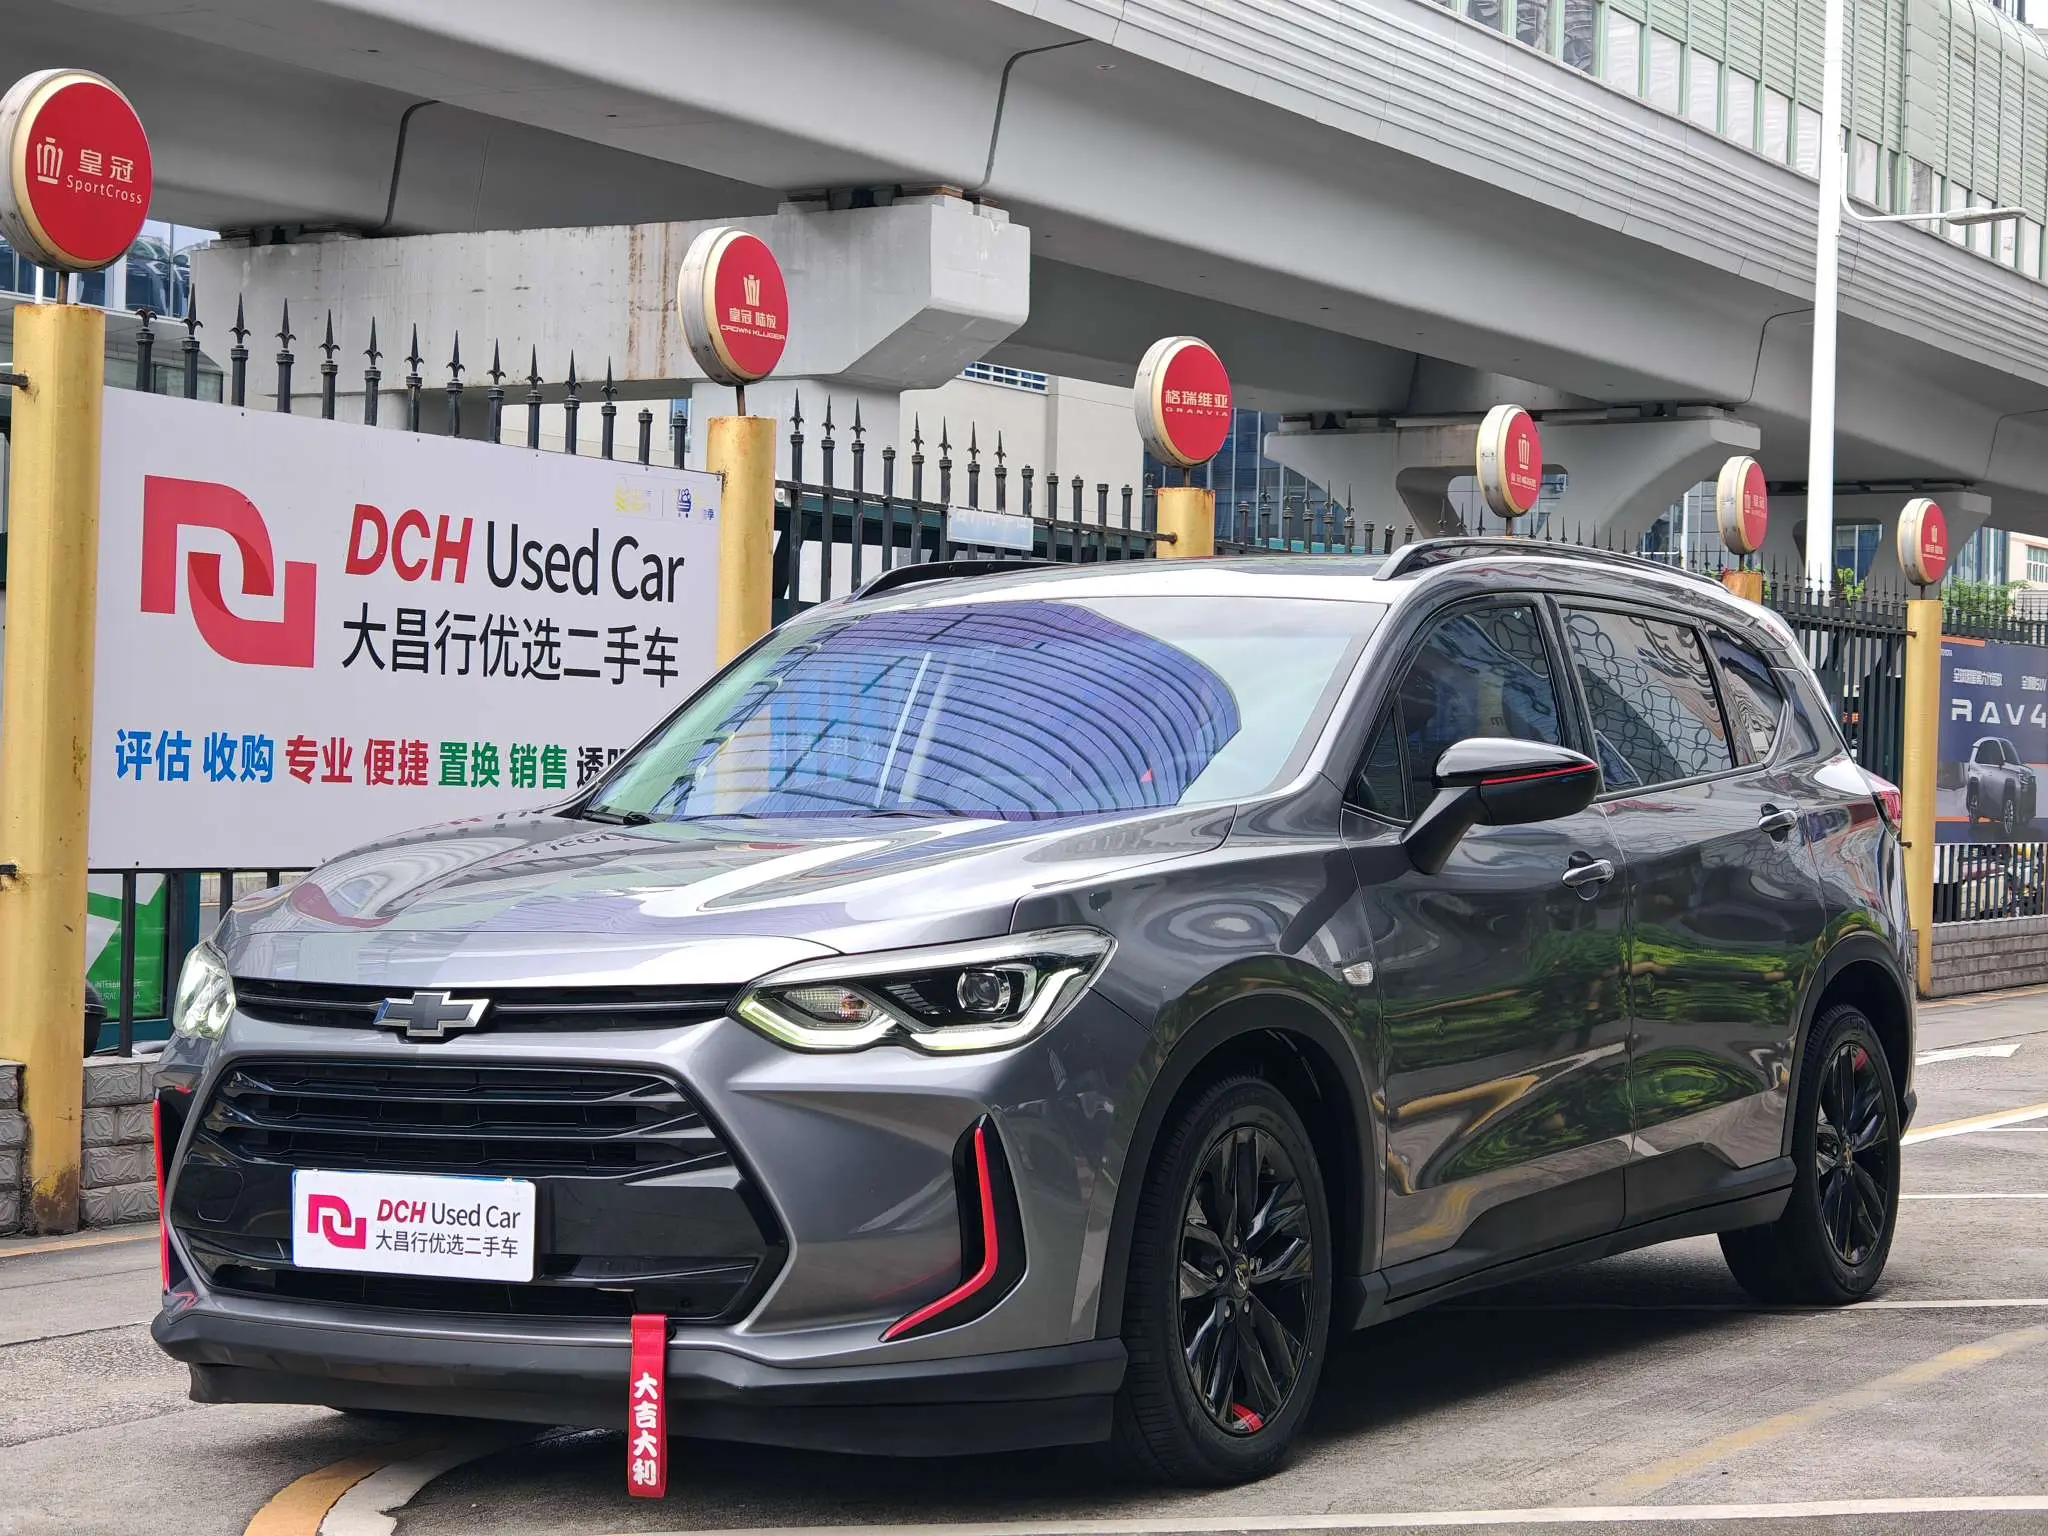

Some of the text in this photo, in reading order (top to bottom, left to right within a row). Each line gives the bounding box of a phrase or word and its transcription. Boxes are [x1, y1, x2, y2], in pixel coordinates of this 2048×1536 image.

[78, 149, 134, 183] 皇冠
[66, 175, 142, 204] SportCross
[1165, 390, 1228, 408] 格瑞维亚
[1166, 407, 1228, 416] GRANVIA
[345, 503, 686, 604] DCH Used Car
[342, 602, 680, 688] 大昌行优选二手车
[1951, 698, 2047, 729] RAV4
[116, 729, 193, 784] 评估
[203, 731, 275, 785] 收购
[286, 735, 354, 786] 专业
[364, 738, 430, 787] 便捷
[438, 741, 502, 789] 置换
[509, 743, 569, 790] 销售
[377, 1199, 521, 1230] DCH Used Car
[375, 1229, 519, 1259] 大昌行优选二手车
[632, 1371, 658, 1486] 大吉大利
